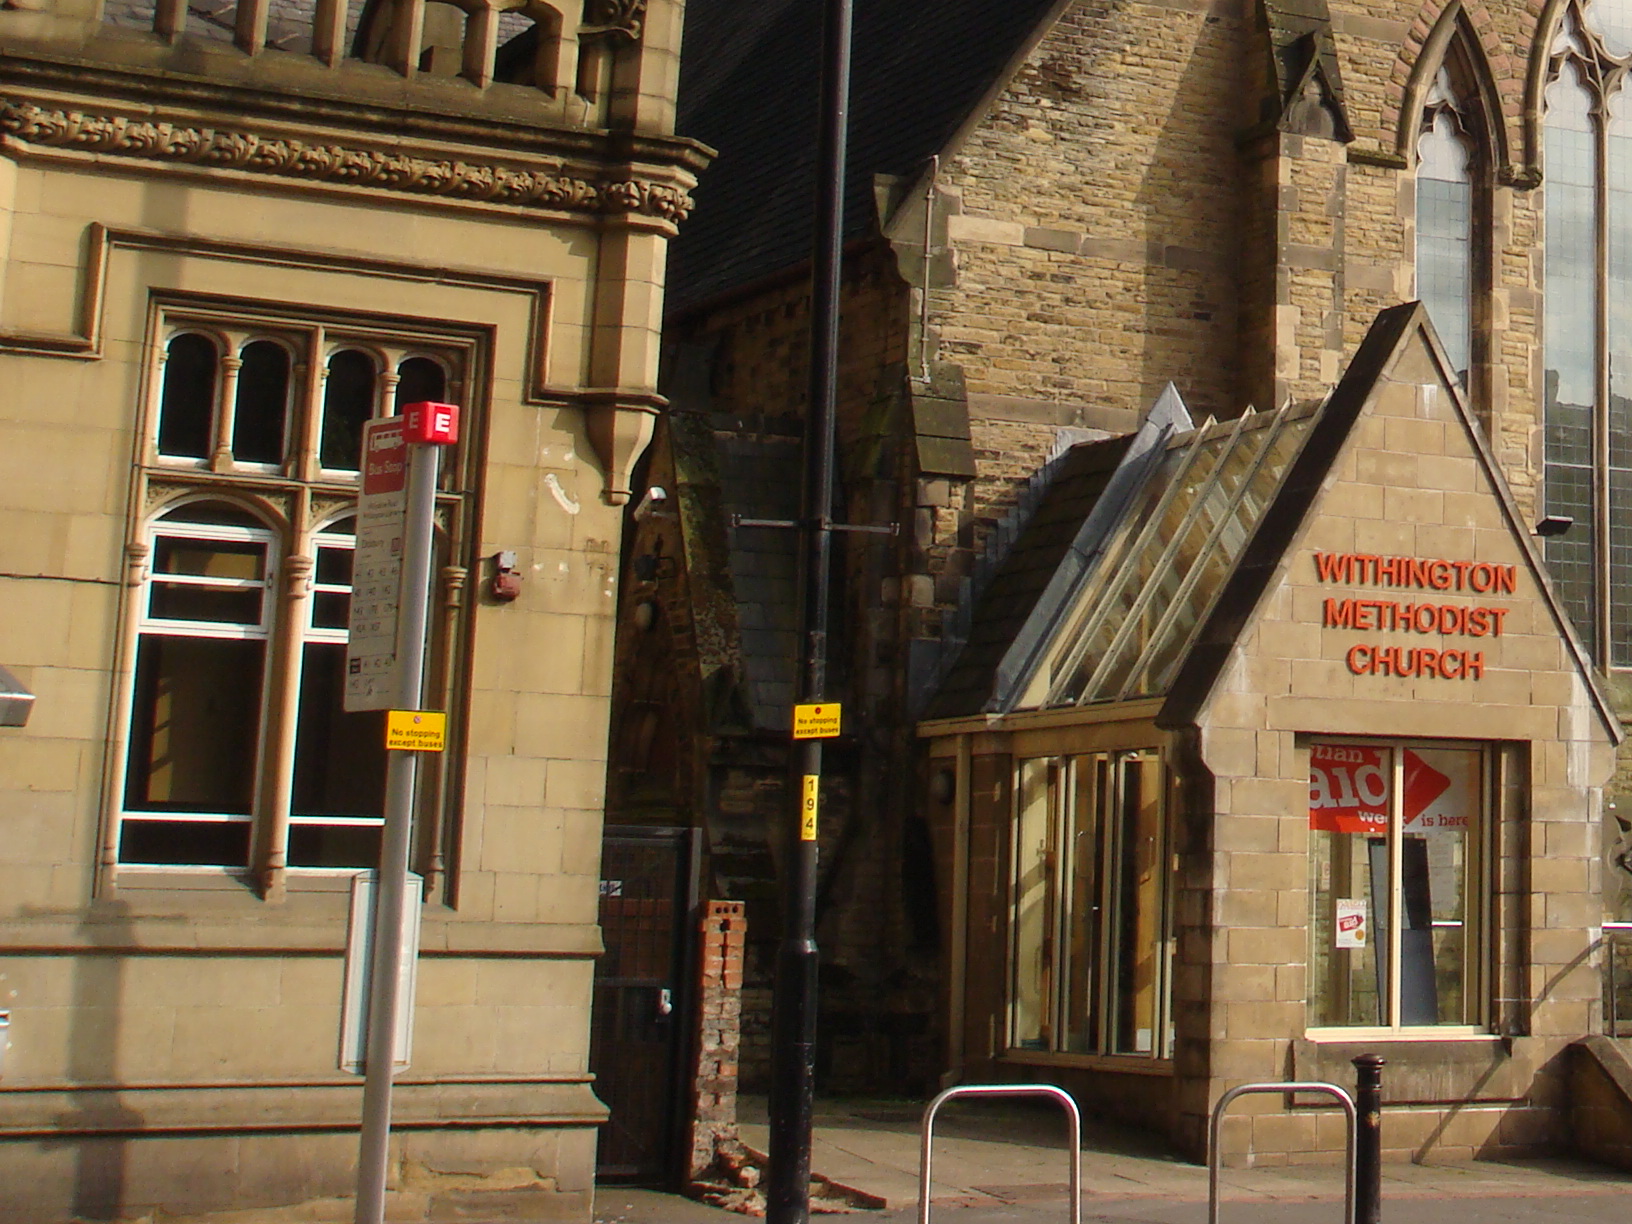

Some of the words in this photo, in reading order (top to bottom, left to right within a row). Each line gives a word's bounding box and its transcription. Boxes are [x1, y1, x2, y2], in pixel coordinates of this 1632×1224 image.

[409, 412, 419, 429] E
[435, 412, 451, 433] E
[369, 463, 383, 476] Bus
[385, 460, 402, 475] Stop
[1315, 552, 1517, 594] WITHINGTON
[1323, 598, 1510, 638] METHODIST
[1347, 643, 1486, 679] CHURCH
[389, 739, 416, 748] except
[418, 739, 443, 748] buses
[391, 728, 404, 737] No
[405, 729, 440, 740] stopping
[1309, 749, 1389, 809] aid
[1421, 813, 1434, 826] is
